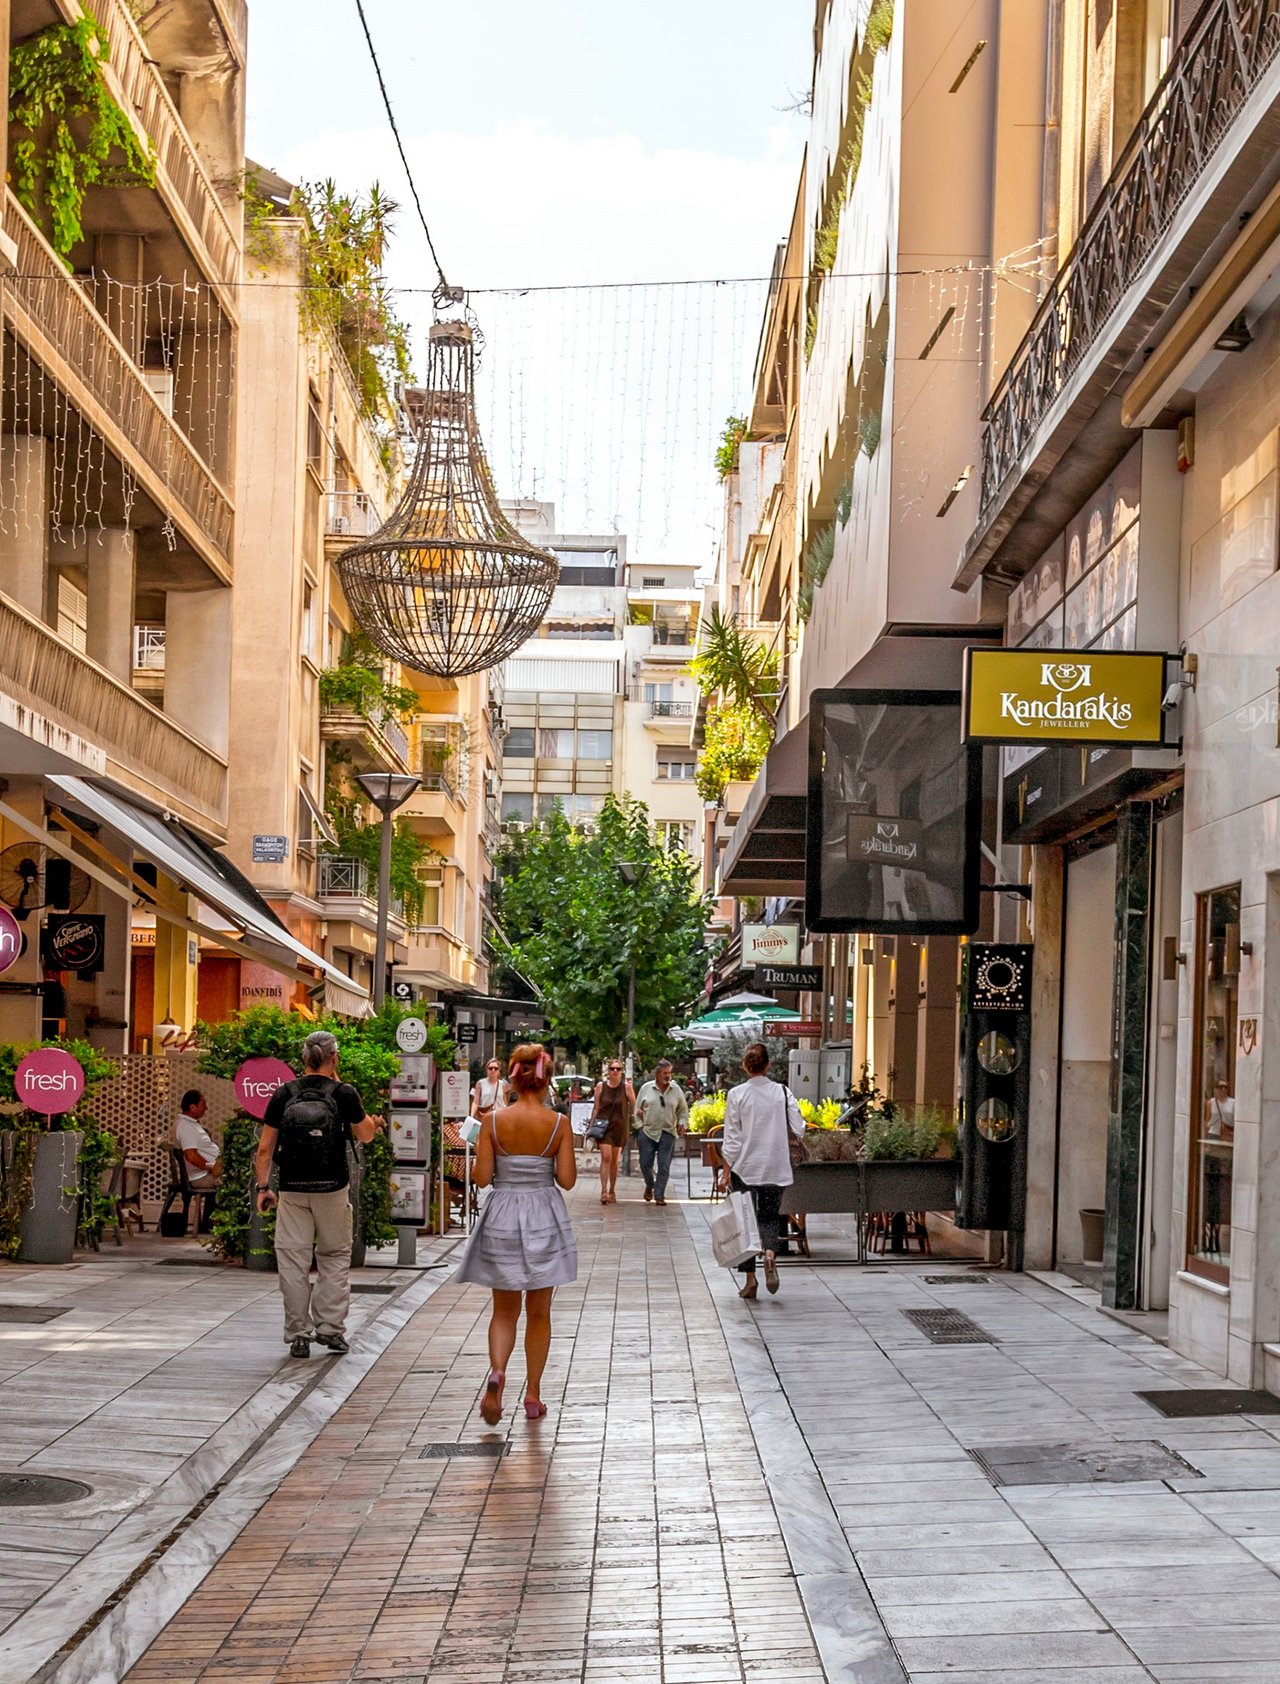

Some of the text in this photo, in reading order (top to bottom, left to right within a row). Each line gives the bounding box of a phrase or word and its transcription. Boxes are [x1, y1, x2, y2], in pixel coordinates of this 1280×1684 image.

[1000, 692, 1133, 729] Kandarakis
[1039, 720, 1091, 729] JEWELLERY
[763, 968, 818, 984] TRUMAN
[241, 986, 282, 997] IOANNIDIS
[399, 1027, 424, 1041] fresh
[24, 1069, 77, 1091] fresh
